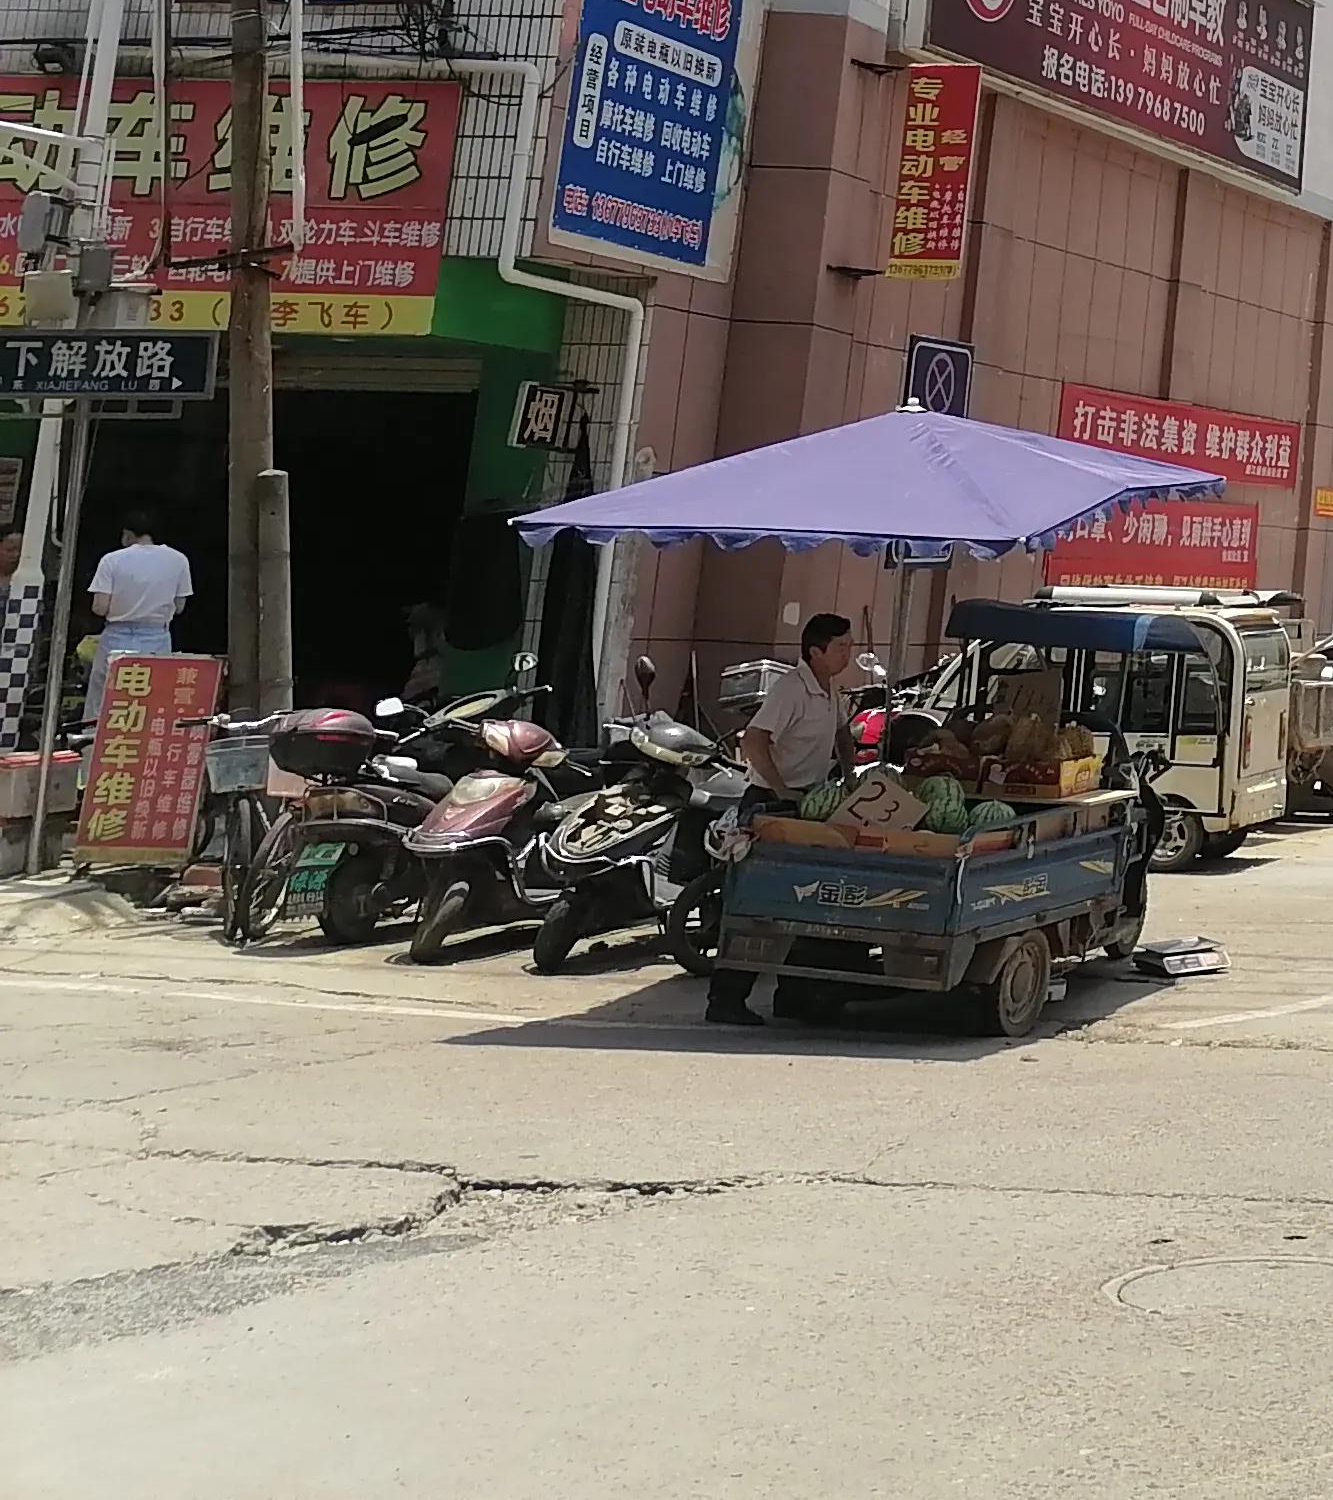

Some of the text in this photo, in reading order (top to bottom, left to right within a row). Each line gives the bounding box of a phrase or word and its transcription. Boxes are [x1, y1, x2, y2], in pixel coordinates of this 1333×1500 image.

[620, 26, 717, 83] 原装电瓶以旧换新
[578, 43, 603, 140] 经营项目
[606, 57, 719, 123] 各种电动车维修
[600, 98, 713, 162] 摩托车维修 回收电动车
[939, 128, 968, 172] 经营
[595, 137, 708, 194] 自行车维修 上门维修
[893, 76, 944, 256] 专业电动车维修
[6, 339, 175, 379] 下解放路
[121, 380, 138, 391] LU
[523, 390, 560, 443] 烟
[1073, 400, 1293, 468] 打击非法集资 维护群众利益
[88, 663, 152, 843] 电动车维修
